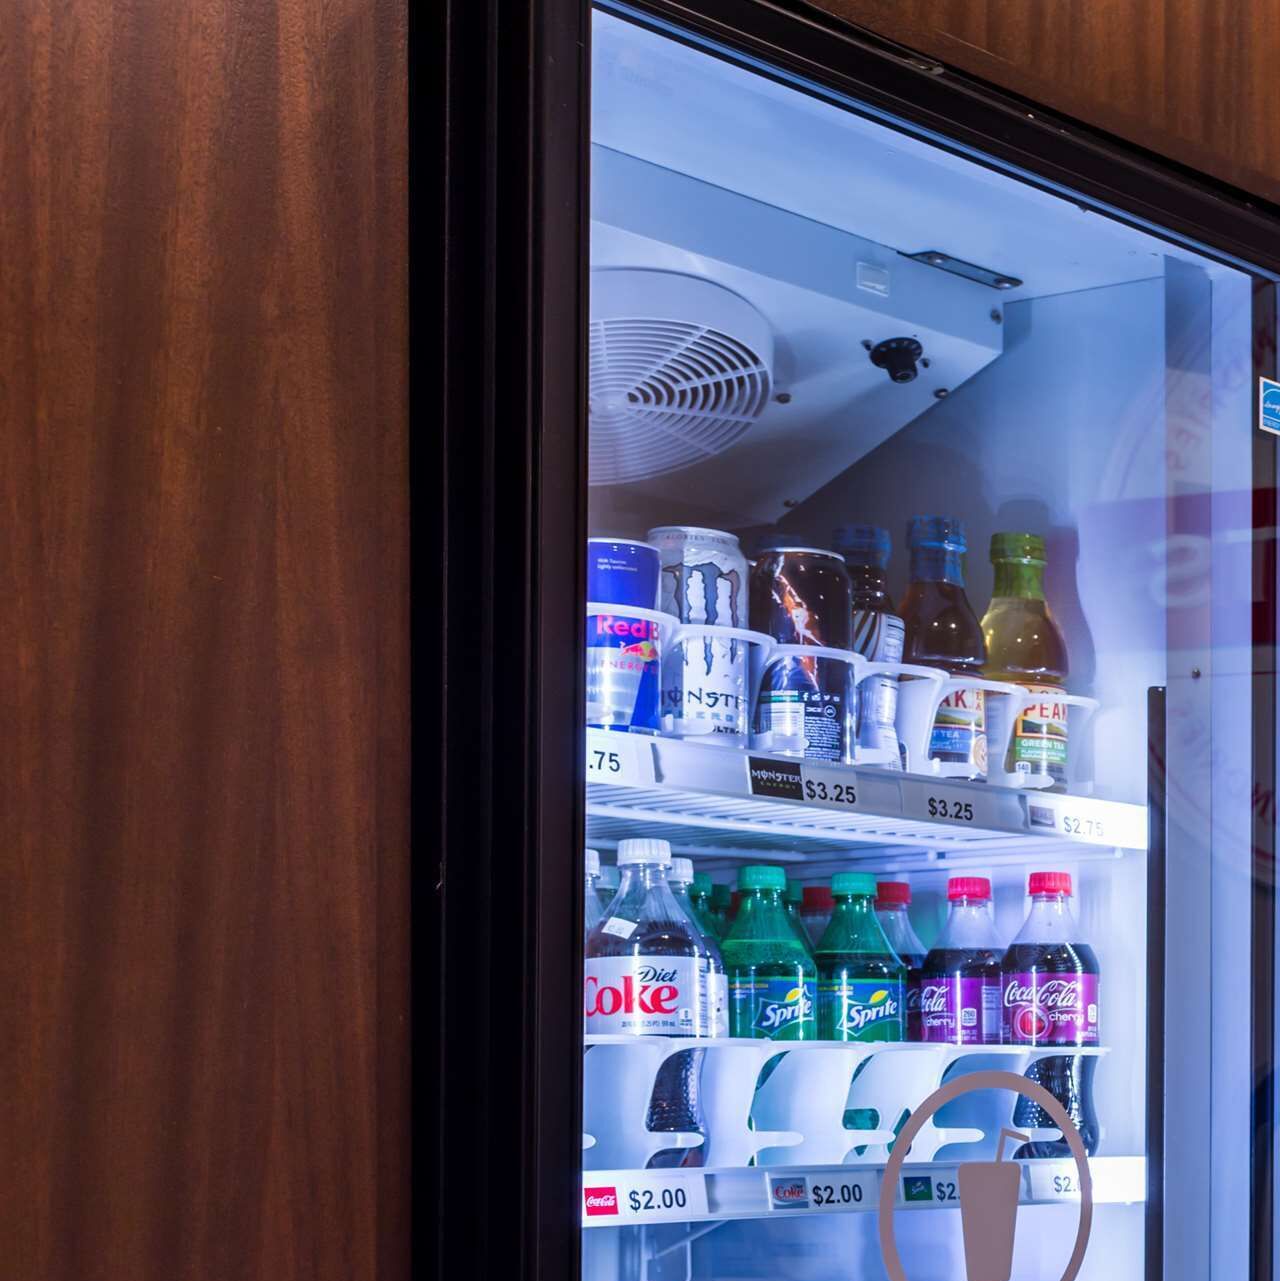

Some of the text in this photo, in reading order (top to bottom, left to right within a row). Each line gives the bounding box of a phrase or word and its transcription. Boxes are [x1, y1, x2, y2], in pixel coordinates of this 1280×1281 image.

[596, 615, 647, 640] Red
[805, 780, 857, 804] $3.25
[928, 797, 974, 821] $3.25
[1063, 816, 1104, 837] $2.75
[638, 965, 678, 983] Diet
[762, 996, 812, 1027] Sprite
[847, 999, 898, 1028] Sprite
[629, 1188, 687, 1214] $2.00
[812, 1183, 863, 1206] $2.00
[936, 1182, 961, 1203] $2.
